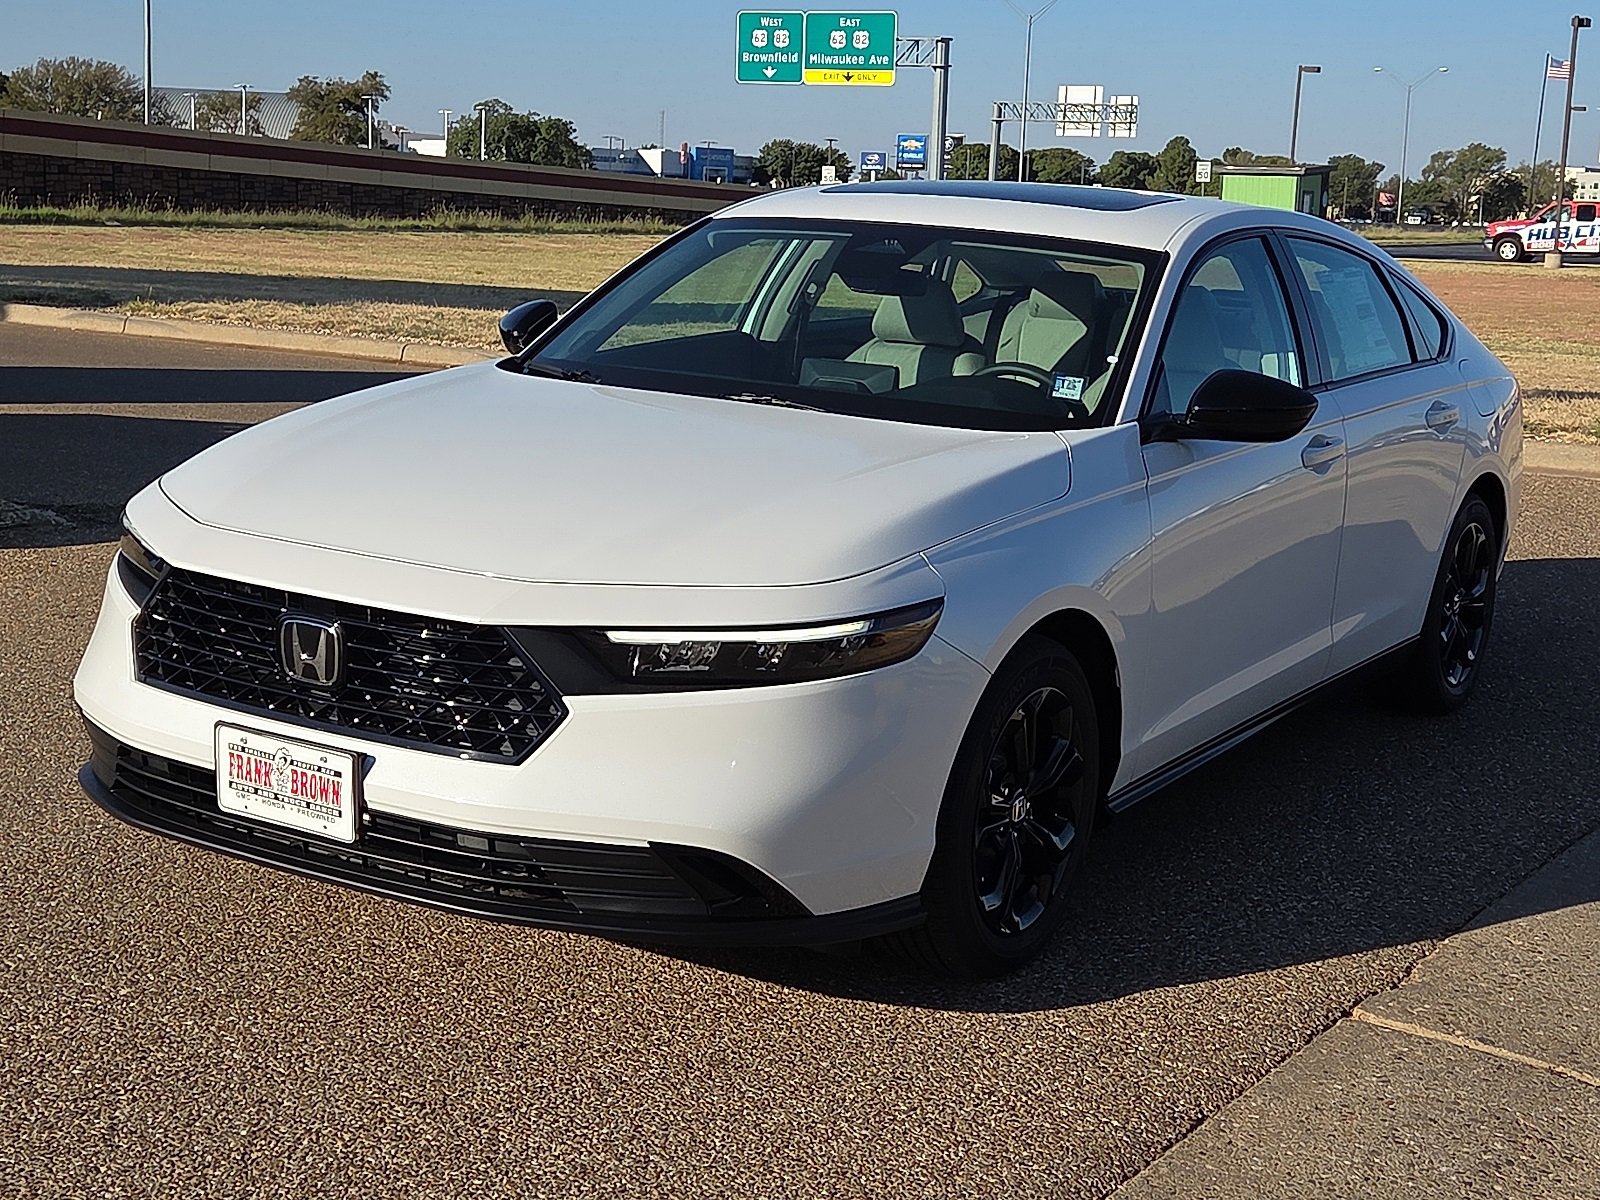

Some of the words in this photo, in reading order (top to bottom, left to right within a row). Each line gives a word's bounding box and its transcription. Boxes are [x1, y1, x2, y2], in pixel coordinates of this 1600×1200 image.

[754, 33, 766, 43] 62
[775, 33, 787, 44] 82
[832, 34, 845, 44] 62
[854, 34, 867, 44] 82
[742, 52, 798, 63] Brownfield
[809, 53, 864, 65] Milwaukee
[868, 54, 889, 65] Ave
[823, 73, 839, 81] EXIT
[857, 73, 878, 81] ONLY
[1197, 171, 1209, 179] 50
[1528, 227, 1570, 241] HUB
[228, 752, 273, 789] FRANK
[290, 768, 342, 808] BROWN
[231, 782, 255, 794] AUTO
[257, 789, 275, 799] AND
[276, 794, 308, 808] TRUCK
[309, 803, 340, 817] RANCH
[235, 791, 251, 801] GMC
[261, 798, 286, 811] HONDA
